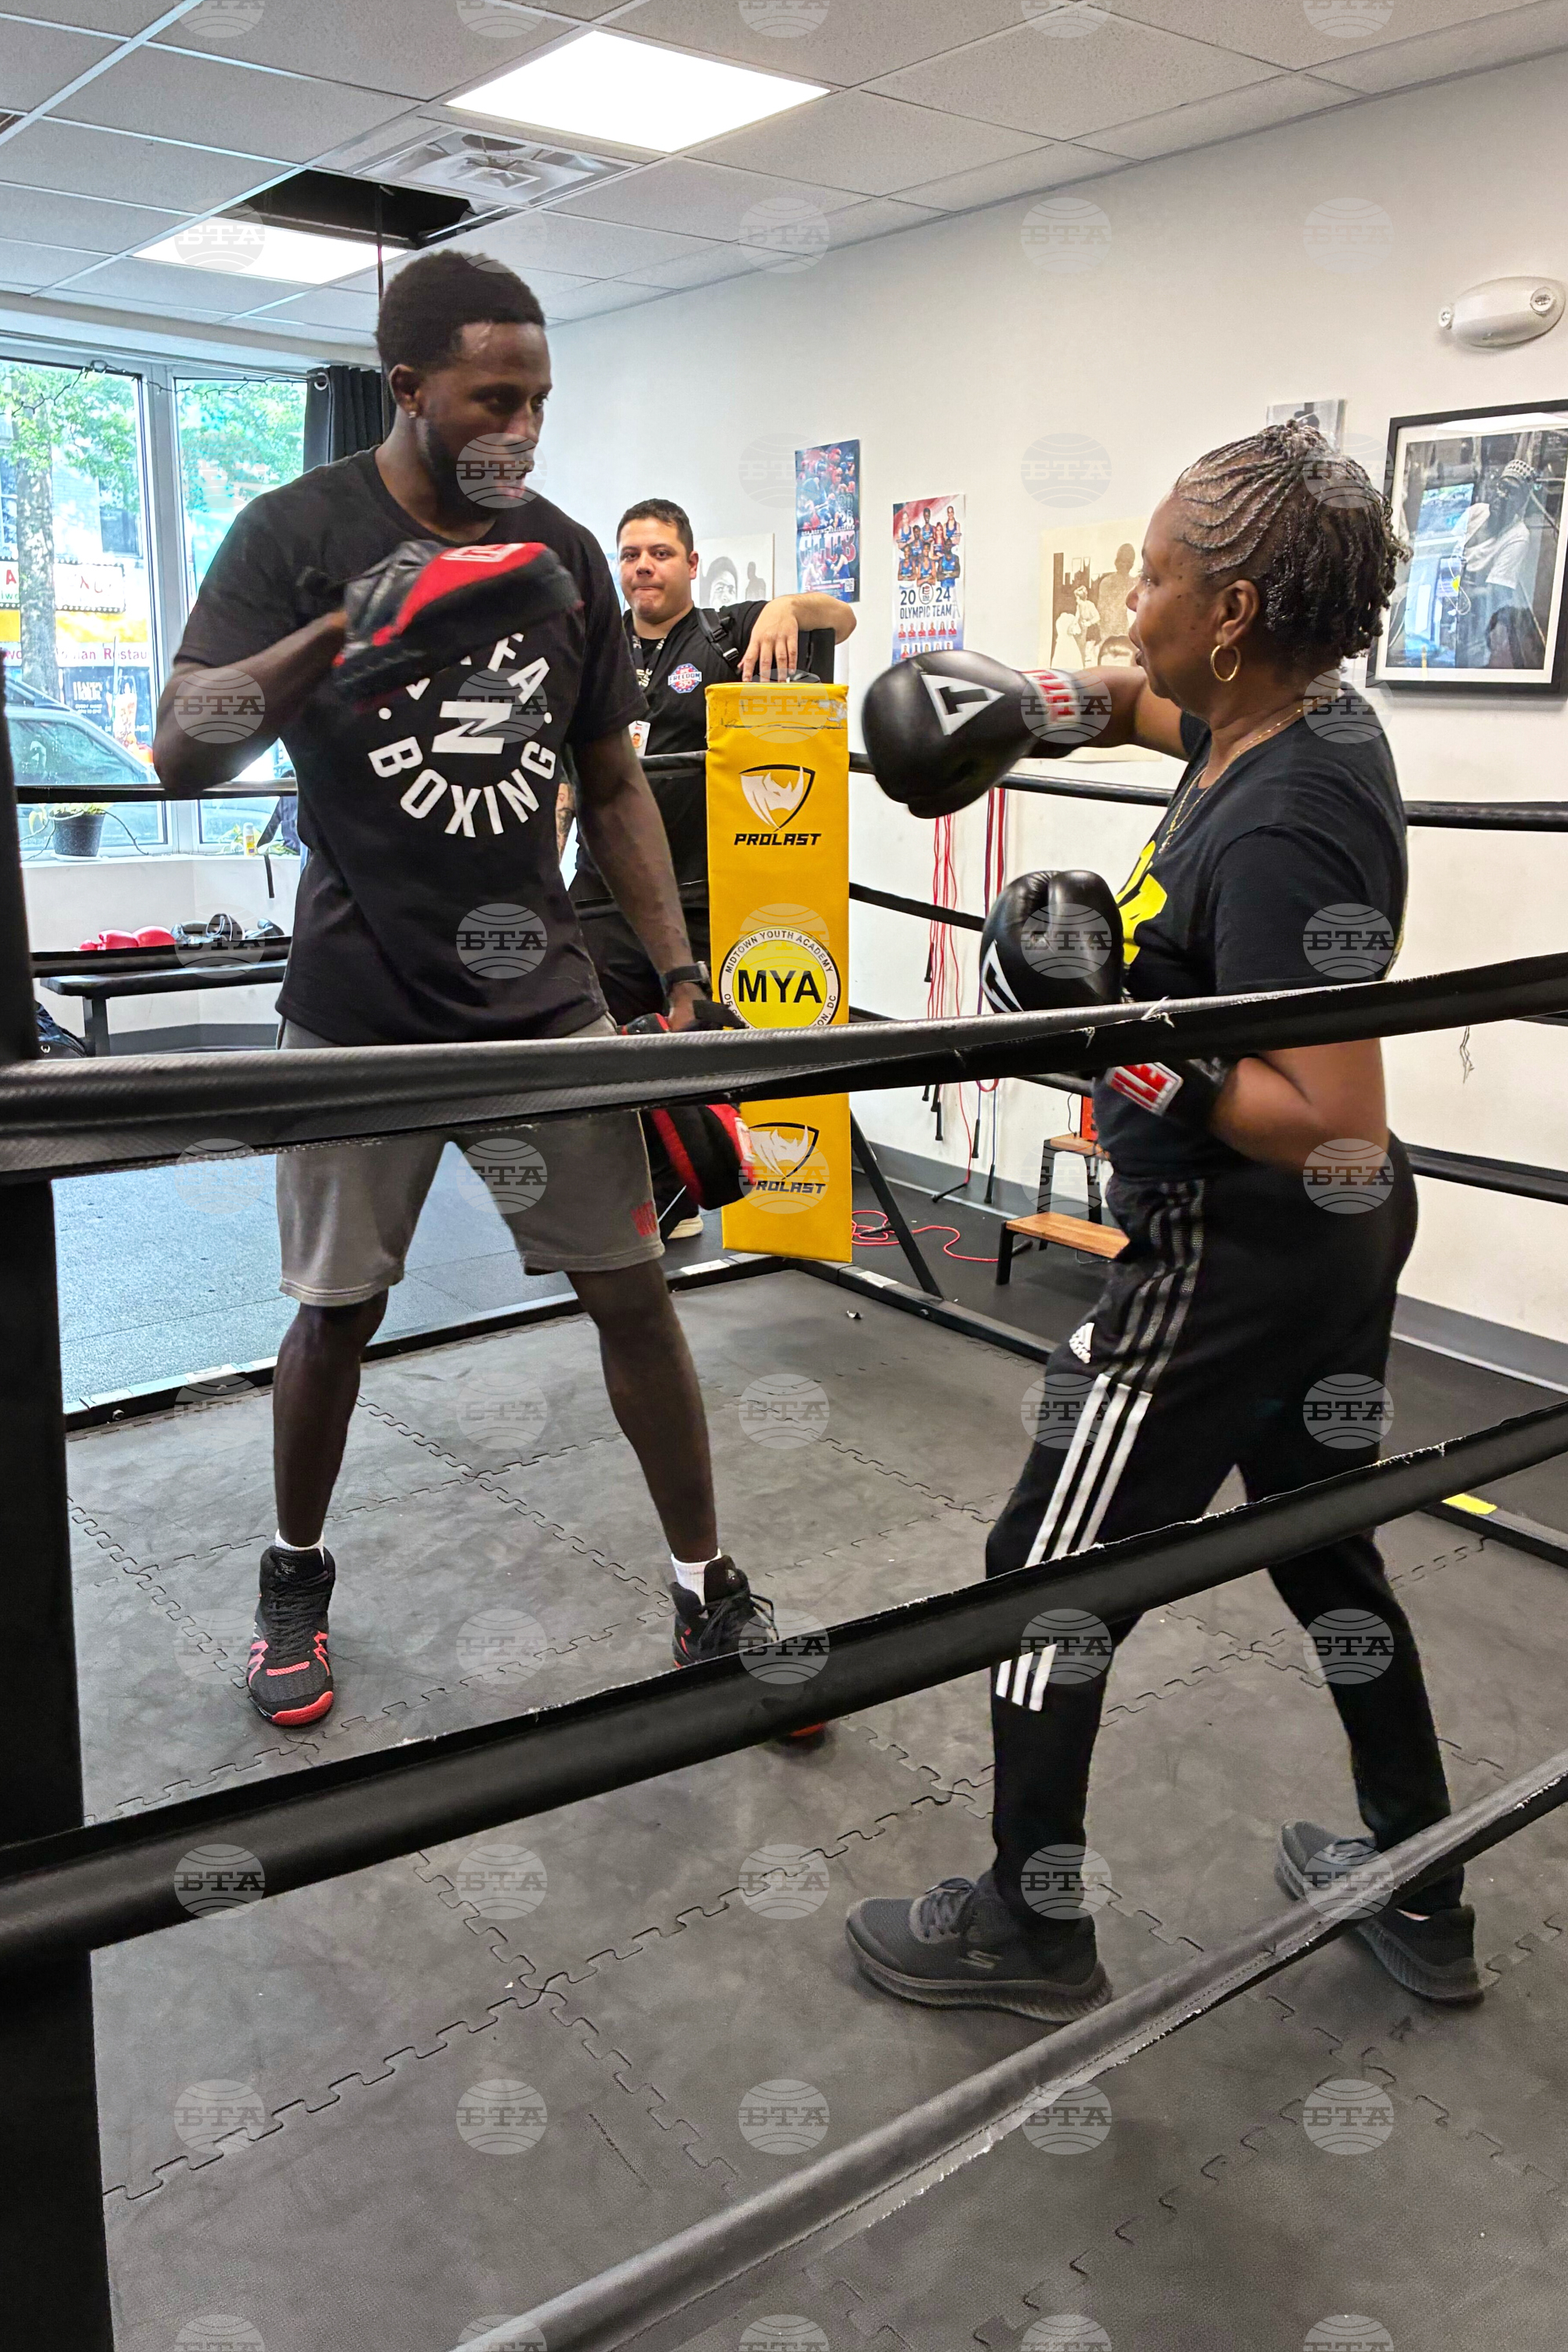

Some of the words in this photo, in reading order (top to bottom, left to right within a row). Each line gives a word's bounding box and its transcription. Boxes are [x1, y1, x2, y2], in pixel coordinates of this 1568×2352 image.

[900, 589, 916, 605] 20
[935, 586, 951, 602] 24
[900, 605, 931, 619] OLYMPIC
[932, 604, 952, 617] TEAM
[670, 673, 701, 684] FREEDOM
[368, 735, 557, 838] BOXING
[734, 833, 822, 846] PROLAST
[725, 936, 758, 974] MIDTOWN
[760, 930, 794, 939] YOUTH
[796, 935, 834, 973] ACADEMY
[738, 969, 823, 1004] MYA
[826, 995, 837, 1009] DC
[754, 1180, 826, 1194] ROLAST
